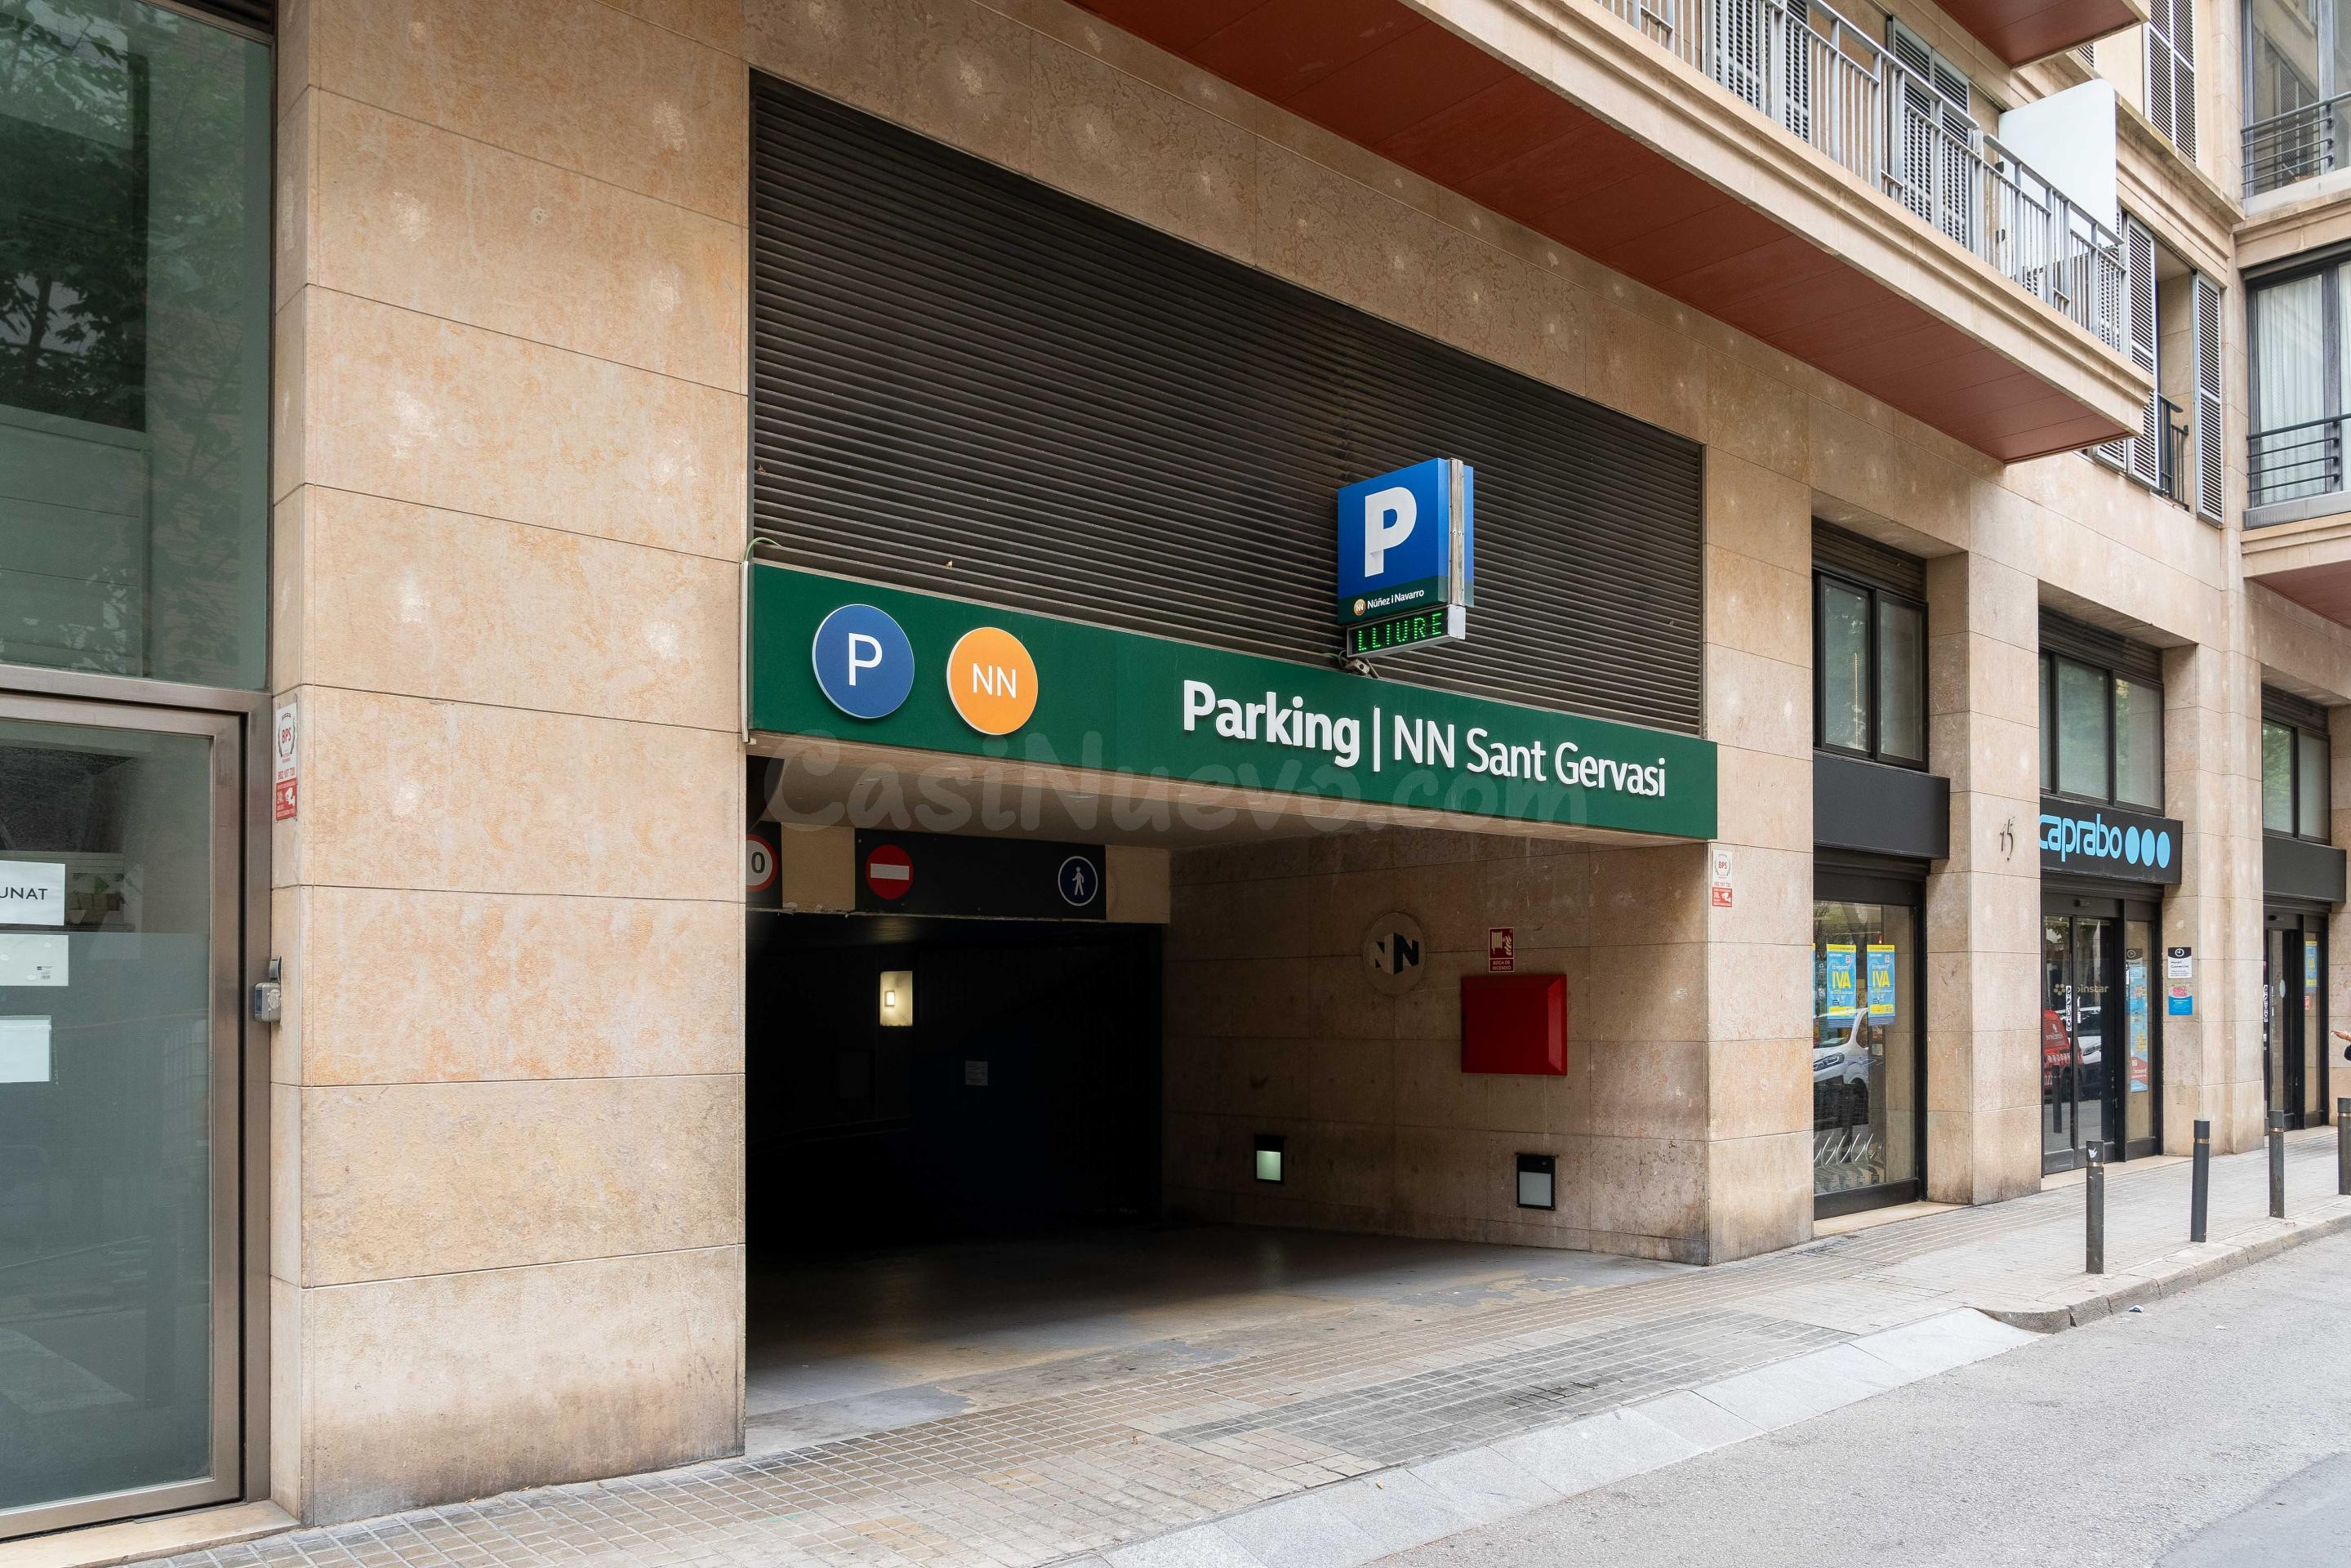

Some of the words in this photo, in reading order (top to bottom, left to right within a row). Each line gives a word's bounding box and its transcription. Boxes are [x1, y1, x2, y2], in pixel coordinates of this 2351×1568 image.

[1365, 486, 1418, 577] P
[1367, 596, 1390, 609] Núñez
[1395, 588, 1424, 604] Navarro
[1358, 612, 1442, 652] LLIURE
[848, 632, 883, 686] P
[972, 662, 1017, 699] NN
[282, 727, 292, 743] BPS
[1183, 679, 1360, 768] Parking
[1394, 715, 1455, 768] NN
[1467, 728, 1547, 782] Sant
[1555, 742, 1666, 797] Gervasi
[2038, 813, 2122, 862] caprabo
[1718, 861, 1727, 870] BPS
[1832, 970, 1851, 989] IVA
[1872, 970, 1890, 988] IVA
